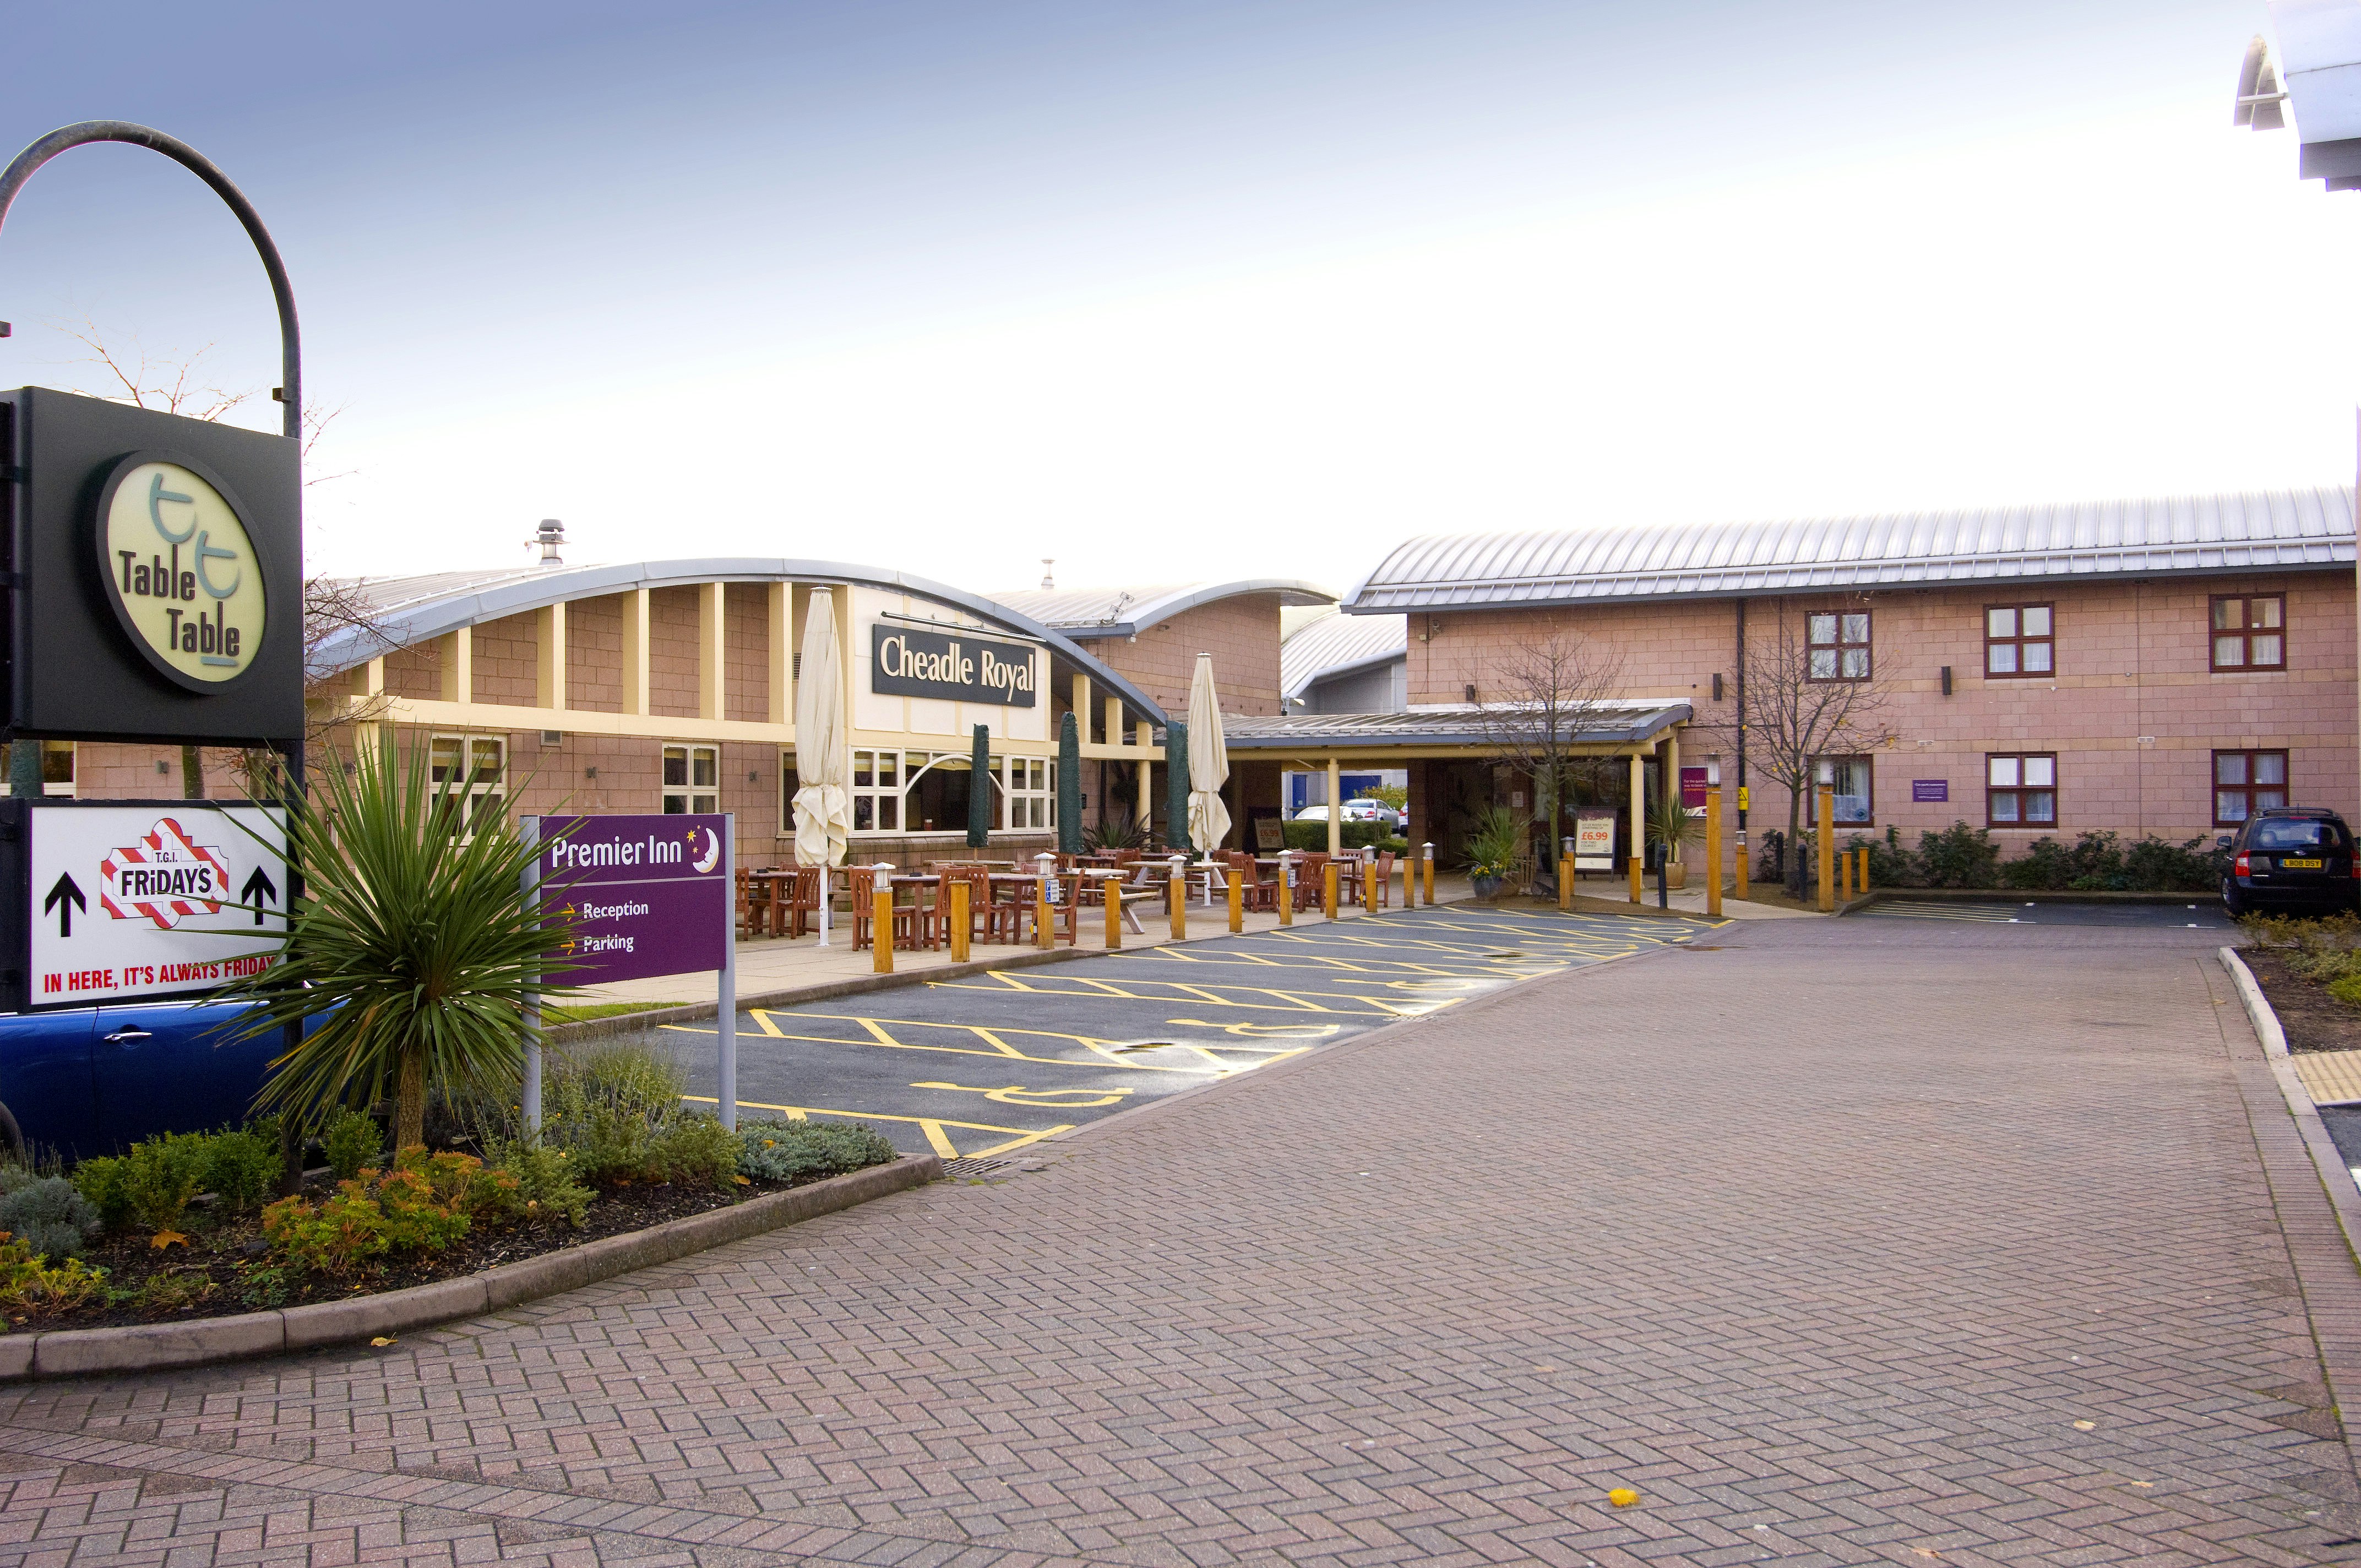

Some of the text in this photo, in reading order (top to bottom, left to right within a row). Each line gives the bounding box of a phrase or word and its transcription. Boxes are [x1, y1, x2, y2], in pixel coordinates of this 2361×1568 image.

[119, 543, 195, 601] Table
[167, 601, 240, 657] Table
[880, 635, 1033, 702] Cheadle Royal
[1581, 831, 1608, 840] £6.99
[156, 852, 178, 862] T.G.I.
[552, 835, 681, 868] Premier Inn
[584, 900, 648, 921] Reception
[584, 933, 634, 952] Parking
[45, 973, 62, 993] IN
[69, 970, 118, 990] HERE,
[124, 966, 154, 986] IT'S
[159, 962, 219, 983] ALWAYS
